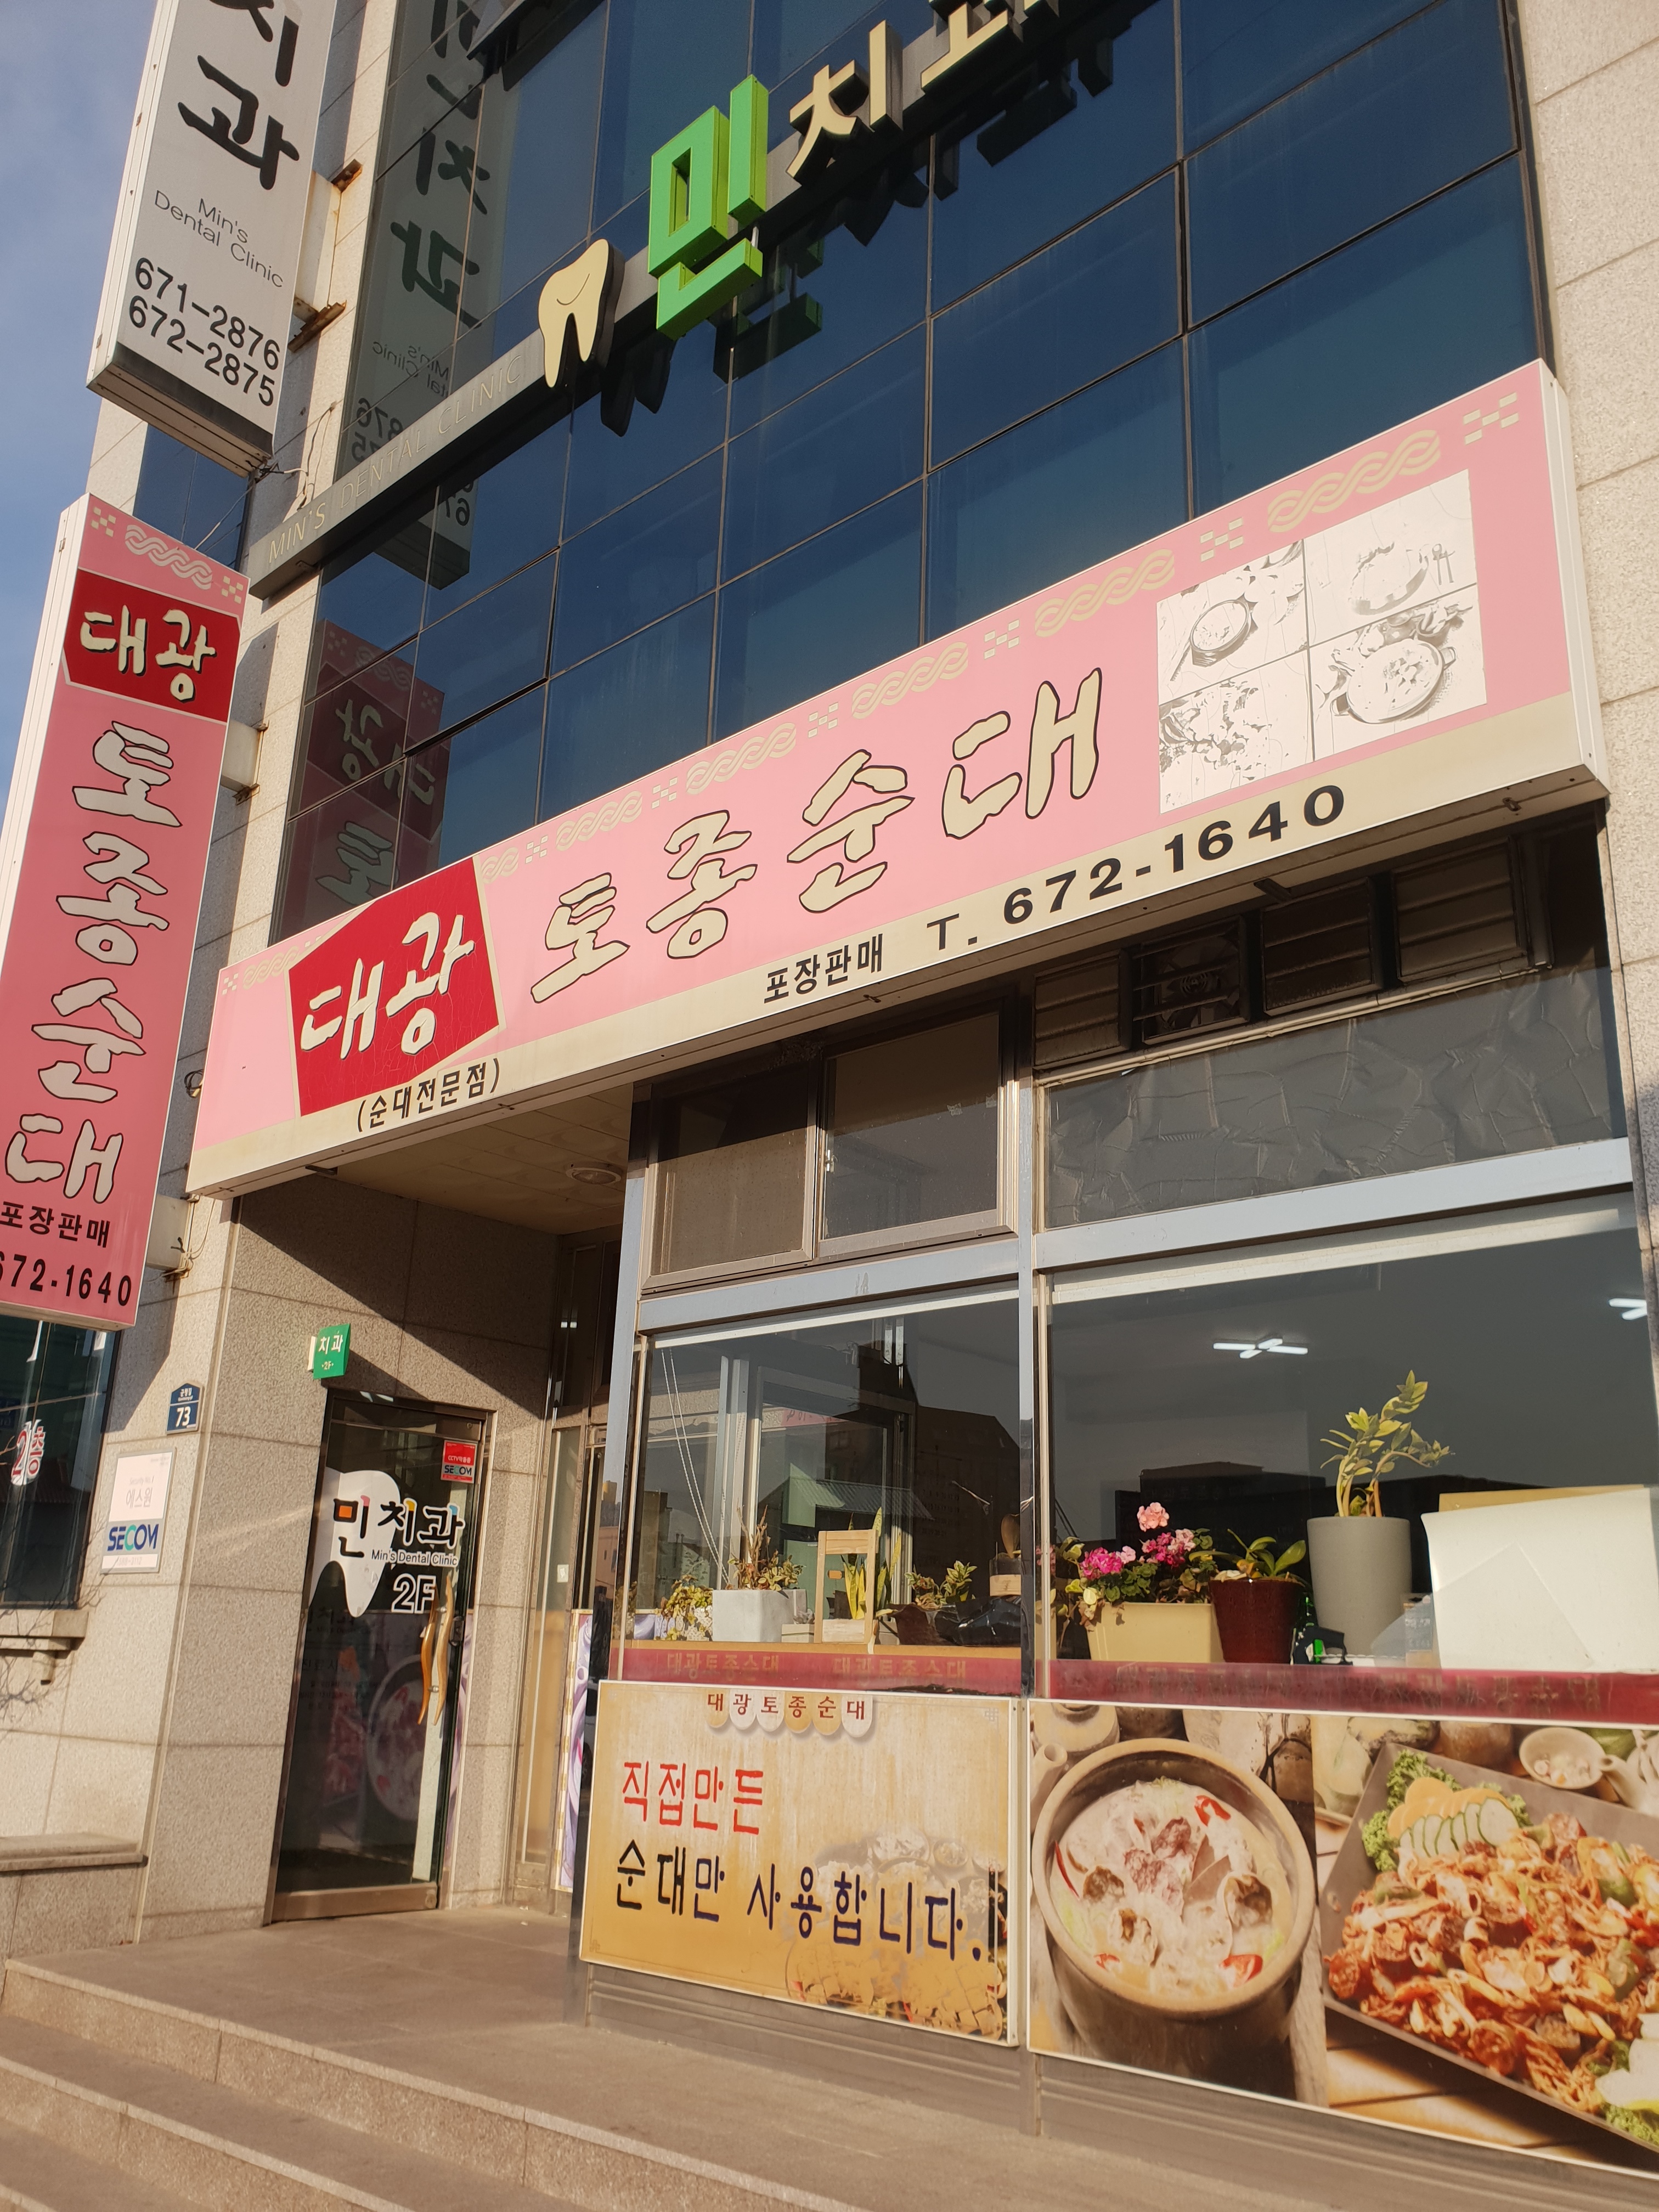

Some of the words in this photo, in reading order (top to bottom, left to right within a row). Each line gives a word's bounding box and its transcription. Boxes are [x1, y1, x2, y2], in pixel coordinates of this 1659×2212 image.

[155, 190, 220, 247] Dental
[230, 243, 284, 289] Clinic
[198, 198, 248, 244] Min's
[129, 295, 274, 407] 672-2875
[135, 257, 280, 371] 671-2876
[268, 503, 325, 563] MIN'S
[340, 436, 427, 509] DENTAL
[439, 355, 521, 435] CLINIC
[80, 604, 217, 703] 대광
[531, 667, 1103, 1003] 토종순대
[763, 933, 883, 1005] 포장판매
[927, 913, 978, 951] T.
[1003, 784, 1345, 925] 672-1640
[5, 720, 183, 1204] 토종순대
[300, 912, 476, 1060] 대광
[357, 1057, 500, 1133] (순대전문점)
[0, 1200, 111, 1248] 포장판매
[318, 1334, 343, 1355] 치과
[176, 1406, 191, 1427] 73
[444, 1465, 472, 1476] SECOM
[107, 1523, 159, 1551] SECOM
[333, 1494, 466, 1559] 민치과
[371, 1549, 396, 1562] Min's
[398, 1550, 430, 1564] Dental
[432, 1553, 458, 1566] Clinic
[391, 1573, 437, 1614] 2F
[708, 1693, 866, 1720] 대광토종순대
[622, 1761, 764, 1835] 직접만든
[616, 1839, 725, 1922] 순대만
[747, 1863, 981, 1962] 사용합니다.
